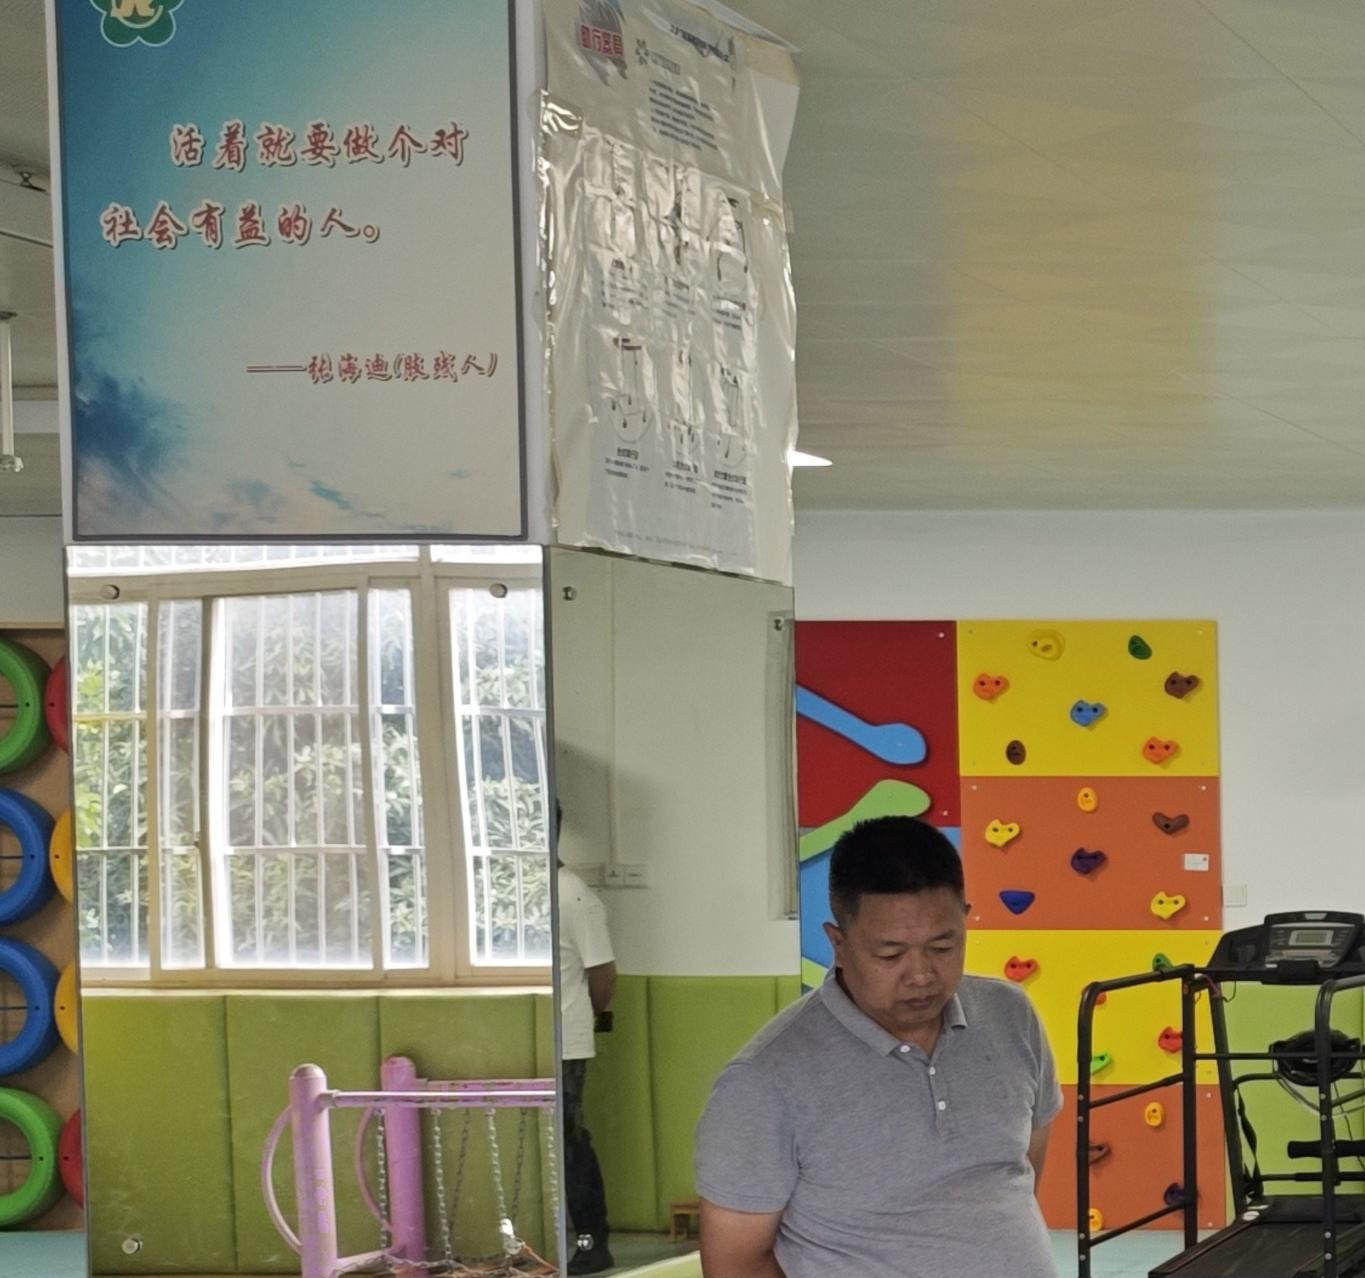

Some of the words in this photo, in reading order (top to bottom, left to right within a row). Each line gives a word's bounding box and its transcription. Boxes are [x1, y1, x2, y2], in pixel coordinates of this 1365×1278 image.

[171, 121, 468, 171] 活着就要做个对
[101, 200, 380, 249] 社会有益的人。
